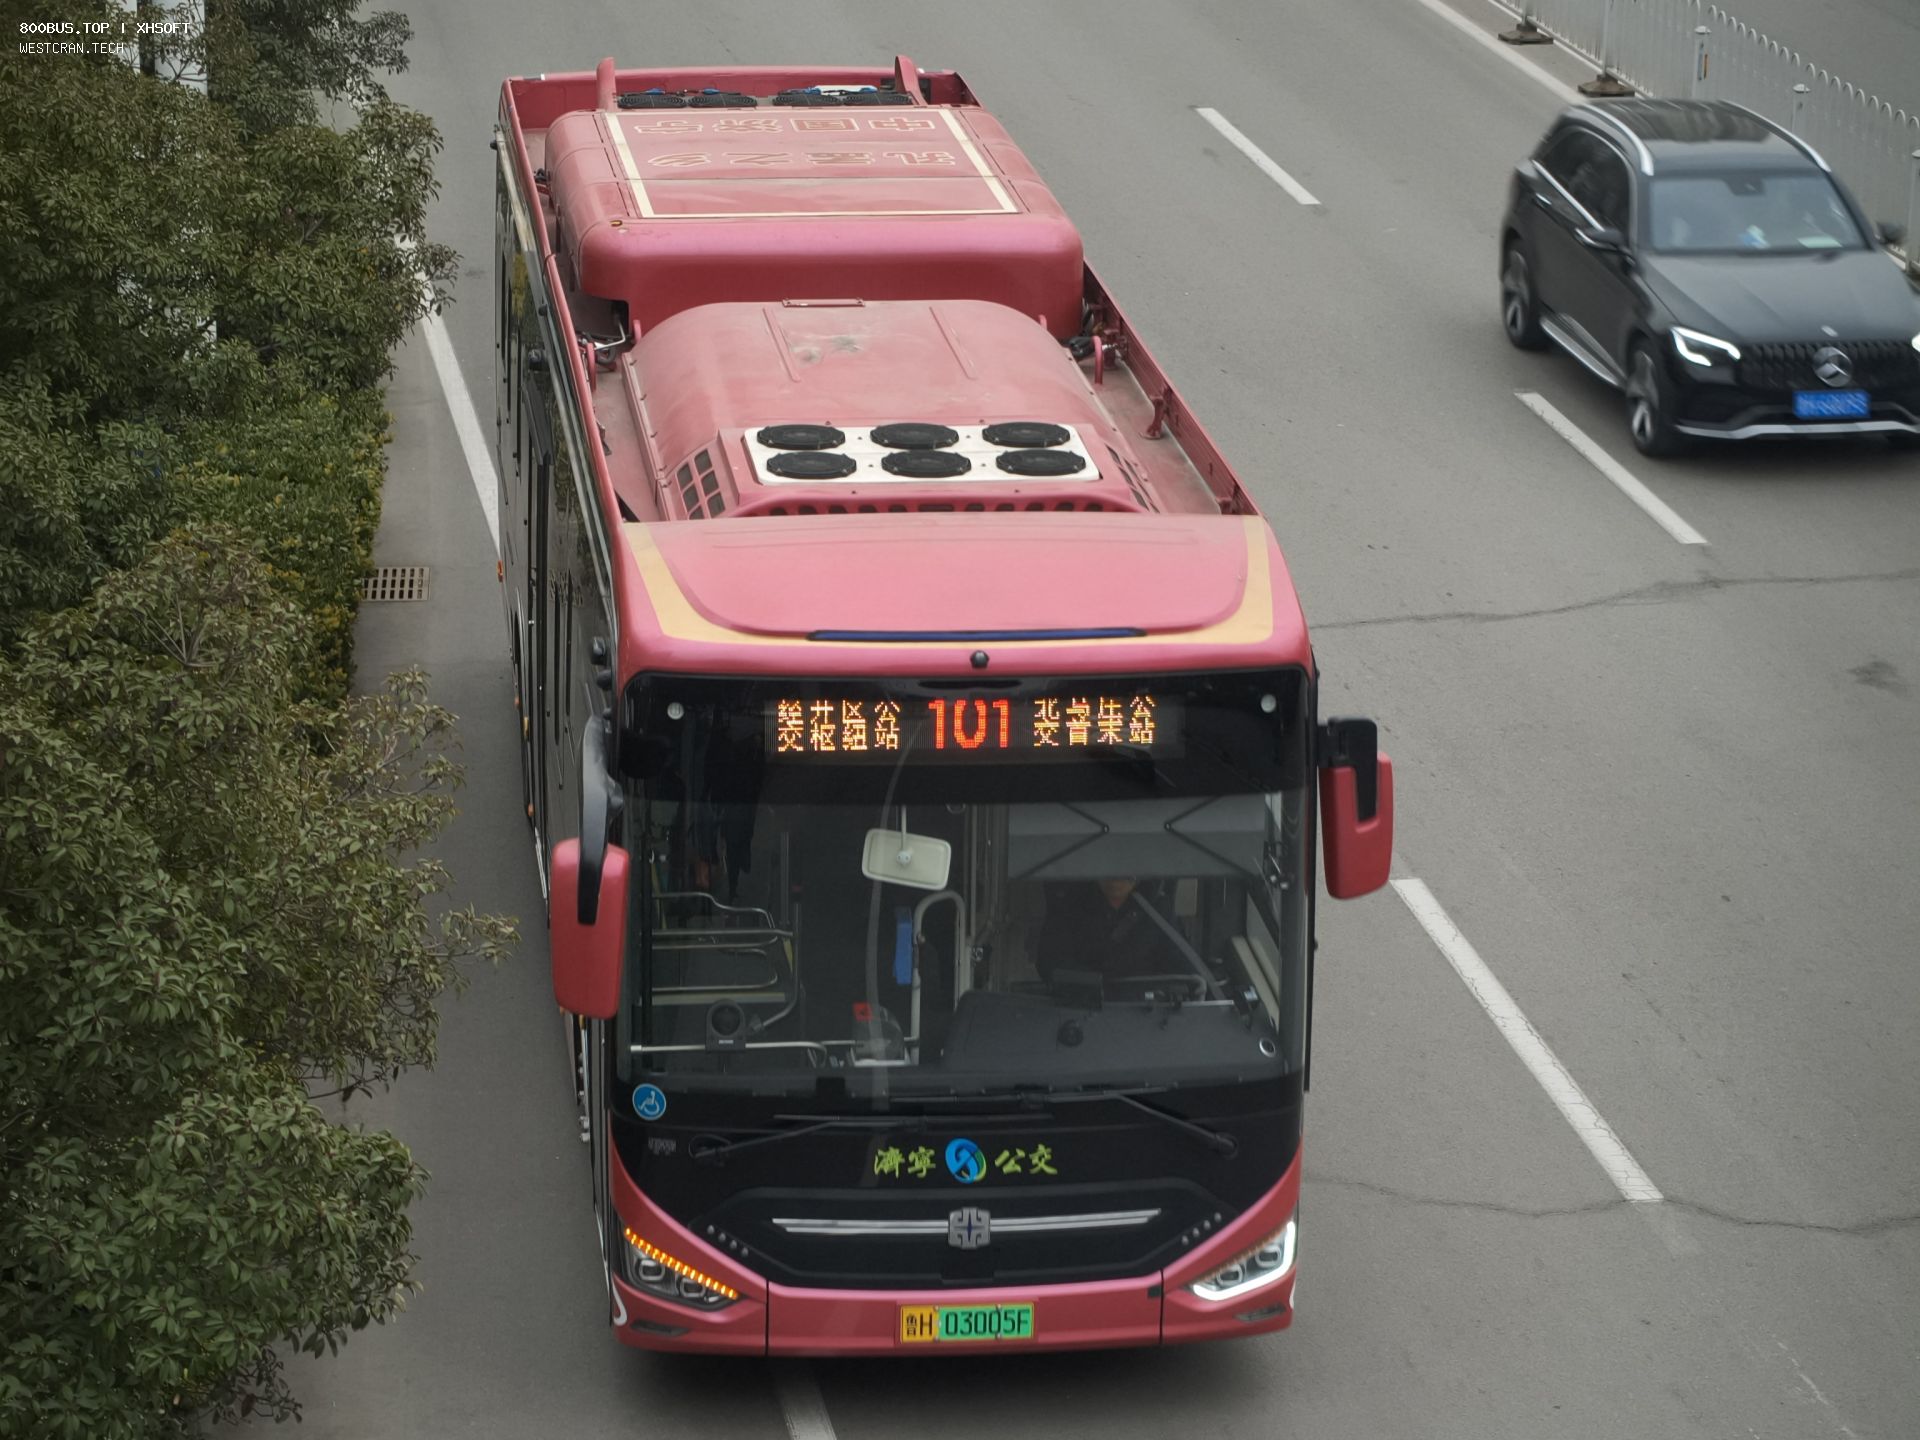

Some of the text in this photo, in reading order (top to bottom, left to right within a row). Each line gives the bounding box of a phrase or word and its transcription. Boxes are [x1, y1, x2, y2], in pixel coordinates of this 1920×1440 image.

[633, 116, 937, 135] 中国济宁
[647, 150, 957, 168] 孔孟之乡
[928, 698, 1009, 749] 101
[994, 1143, 1058, 1175] 公交
[945, 1309, 1030, 1337] 03005F
